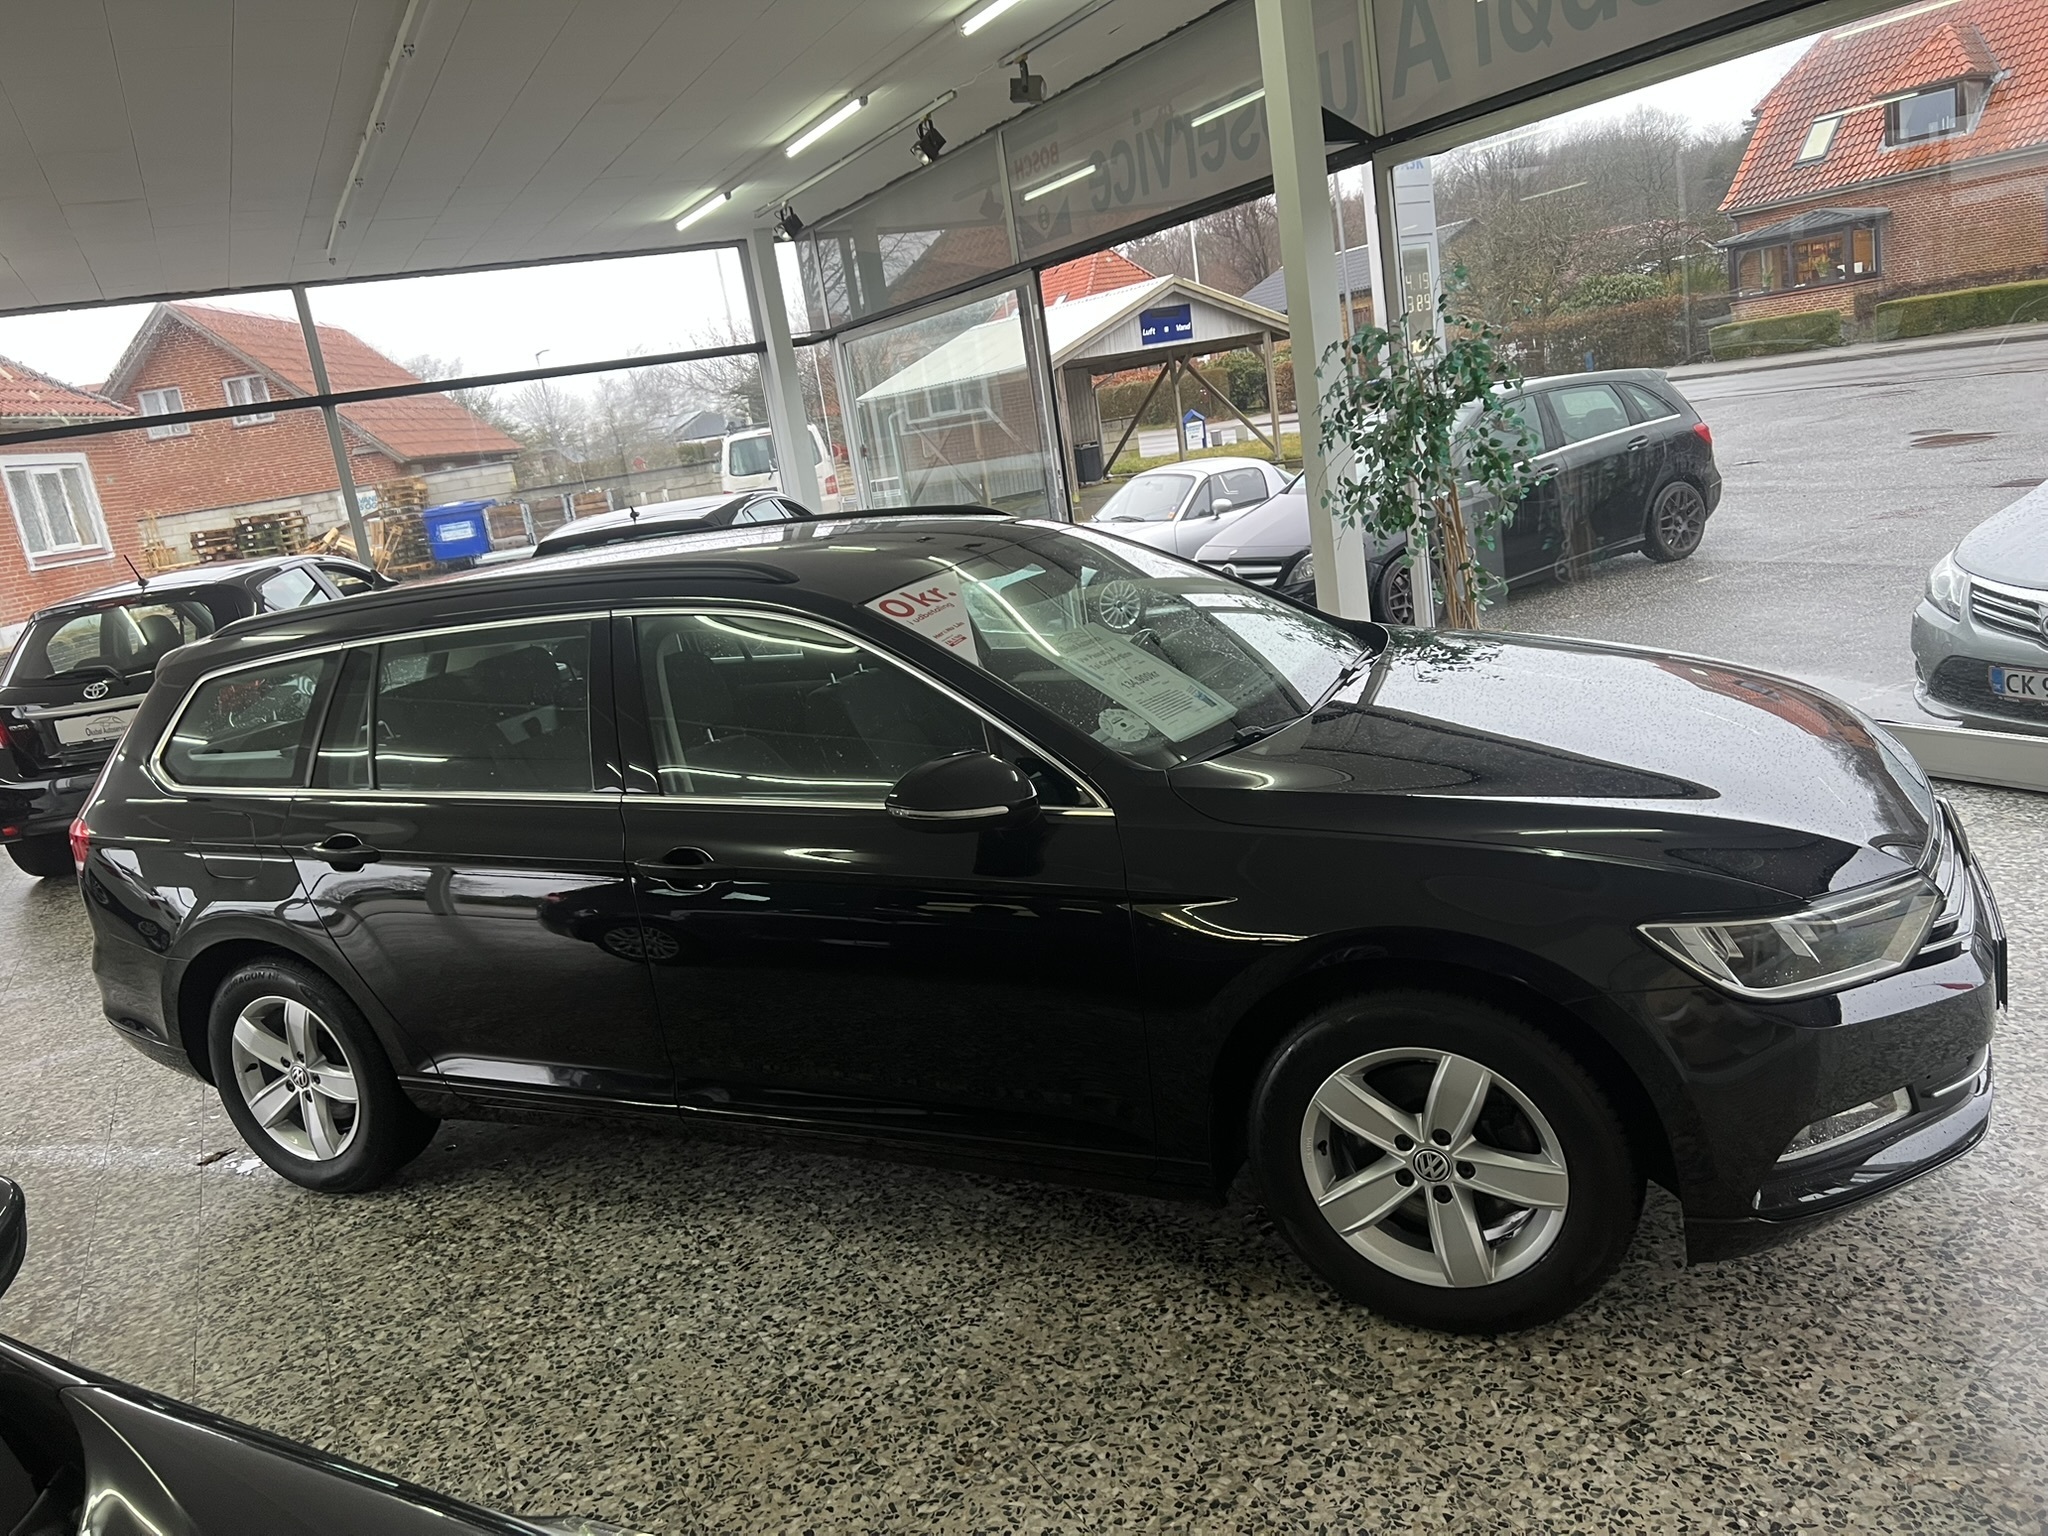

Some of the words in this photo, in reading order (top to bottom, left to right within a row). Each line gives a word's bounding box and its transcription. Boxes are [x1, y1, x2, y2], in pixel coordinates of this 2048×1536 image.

[1142, 327, 1156, 336] Luft
[1176, 322, 1191, 332] Vand
[899, 587, 957, 607] kr.
[915, 602, 955, 623] udbetaling
[2006, 674, 2036, 695] CK
